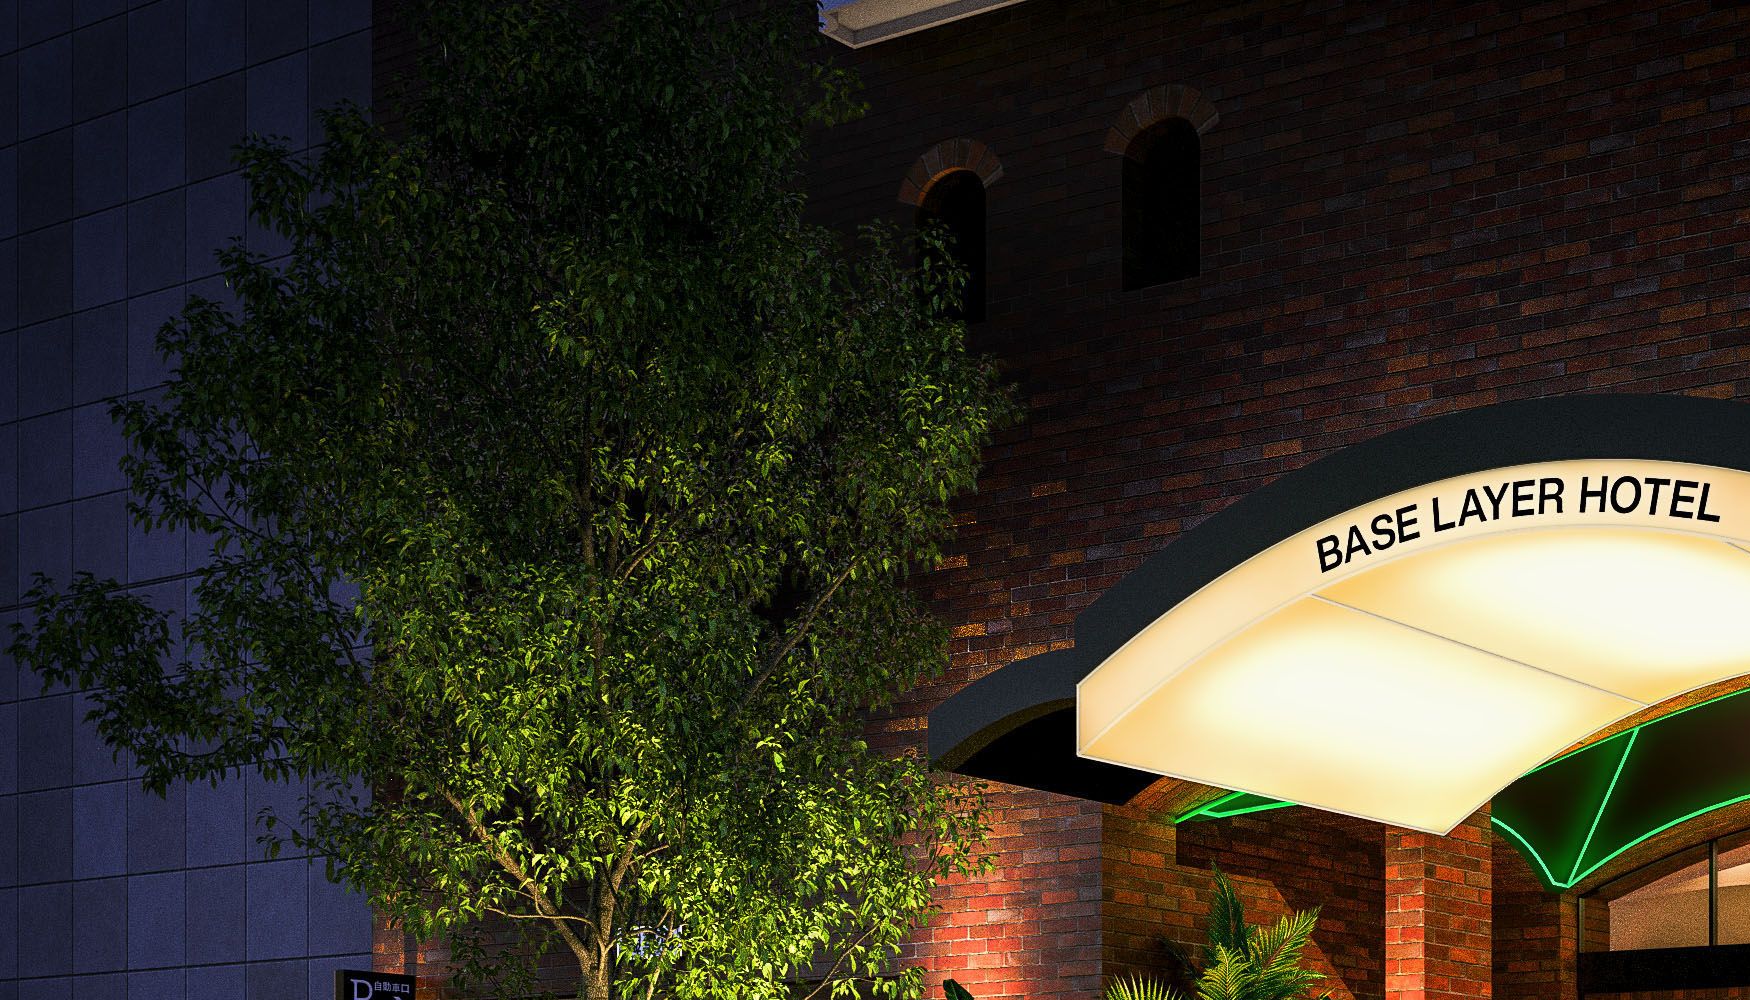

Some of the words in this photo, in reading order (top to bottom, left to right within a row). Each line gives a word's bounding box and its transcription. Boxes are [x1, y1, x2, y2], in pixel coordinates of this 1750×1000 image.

[1316, 503, 1421, 574] BASE
[1432, 477, 1564, 533] LAYER
[1579, 475, 1721, 523] HOTEL
